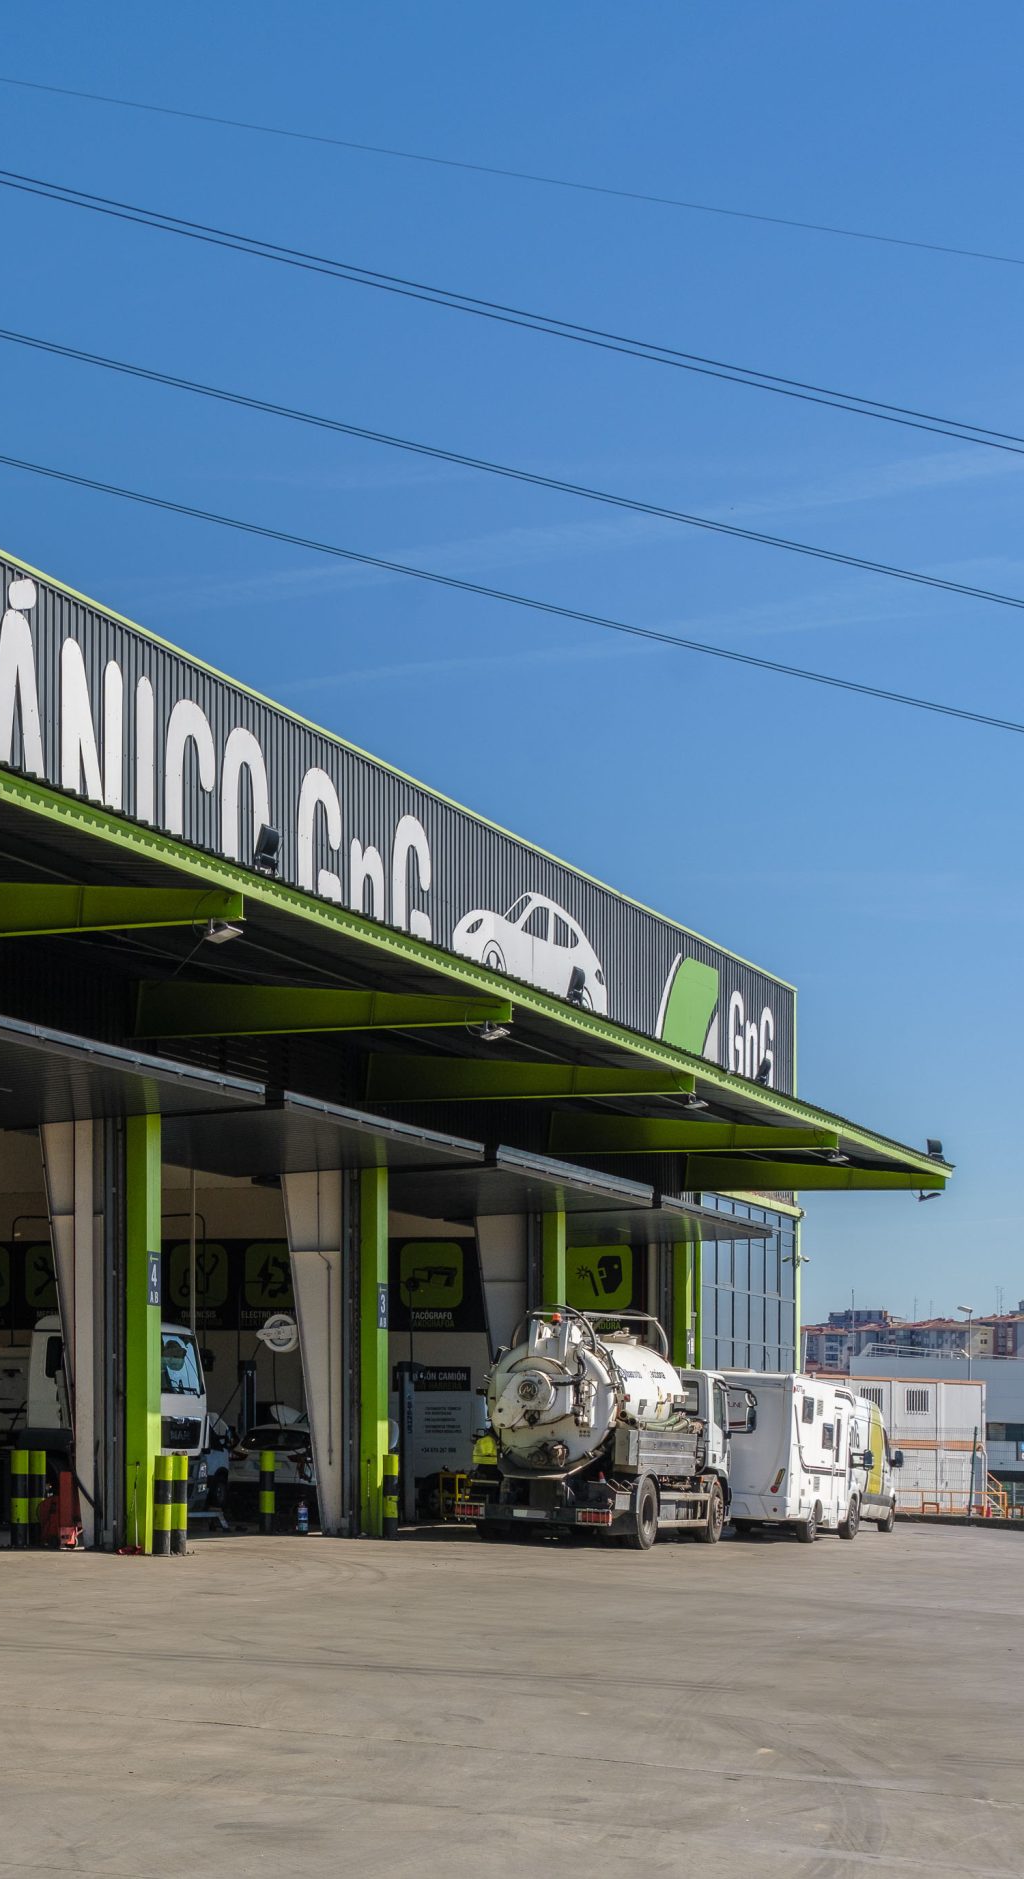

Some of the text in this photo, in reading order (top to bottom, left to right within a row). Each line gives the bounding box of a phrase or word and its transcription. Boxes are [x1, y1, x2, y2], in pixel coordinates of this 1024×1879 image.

[150, 1263, 158, 1287] 4
[380, 1293, 386, 1313] 3
[410, 1308, 453, 1320] TACÓGRAFO
[438, 1368, 468, 1381] CAMIÓN
